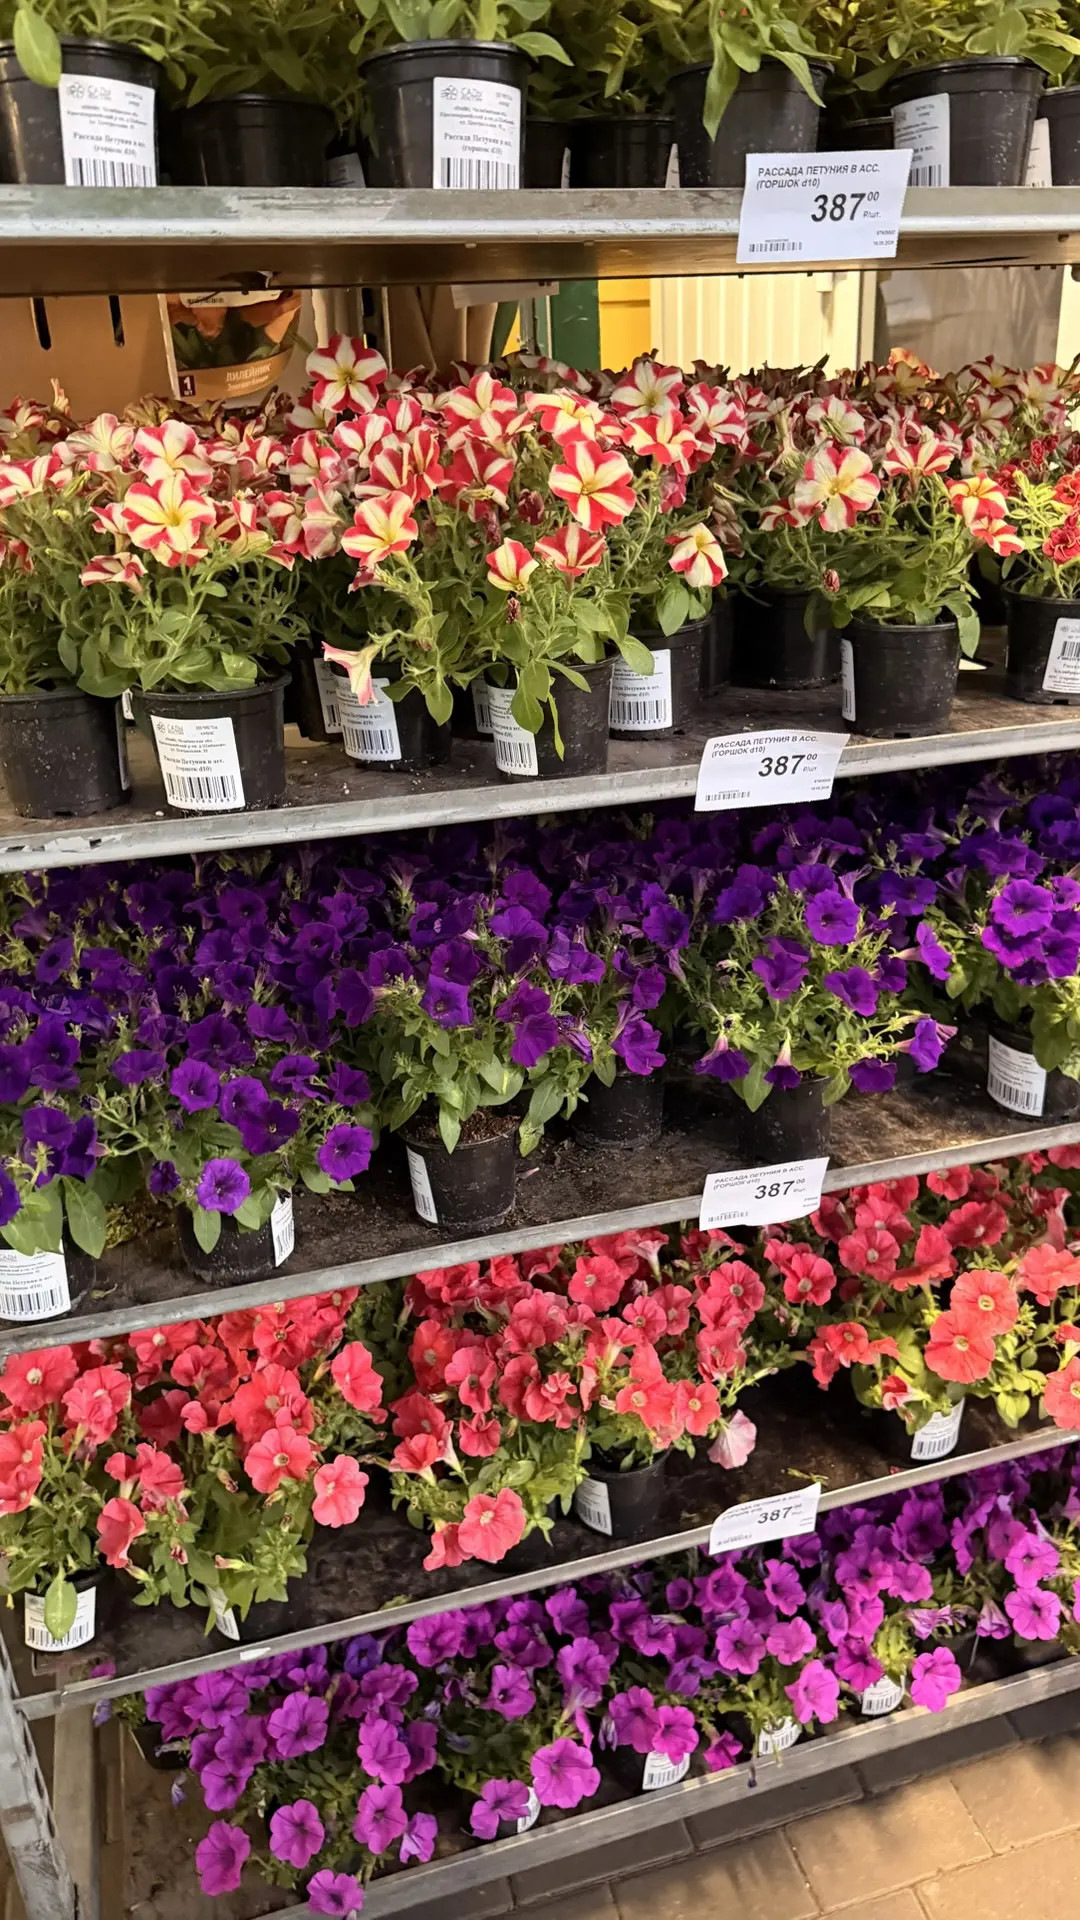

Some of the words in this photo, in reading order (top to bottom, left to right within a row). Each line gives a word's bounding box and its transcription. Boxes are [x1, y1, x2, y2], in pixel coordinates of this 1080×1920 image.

[758, 167, 804, 176] РАССАДА
[807, 164, 848, 175] ПЕТУНИЯ
[850, 165, 857, 173] В
[859, 164, 880, 173] АСС.
[756, 180, 799, 191] (ГОРШОК
[801, 178, 820, 188] d10)
[811, 193, 866, 222] 387
[867, 191, 880, 201] 00
[226, 363, 271, 381] ЛИЛЕЙНИК
[184, 377, 191, 390] 1
[713, 740, 751, 749] РАССАДА
[753, 736, 790, 745] ПЕТУНИЯ
[712, 748, 748, 758] (ГОРШОК
[750, 746, 766, 754] d10)
[758, 754, 806, 777] 387
[715, 1174, 748, 1184] РАССАДА
[750, 1169, 781, 1180] ПЕТУНИЯ
[713, 1181, 745, 1190] (ГОРШОК
[754, 1180, 795, 1199] 387
[757, 1506, 793, 1524] 387
